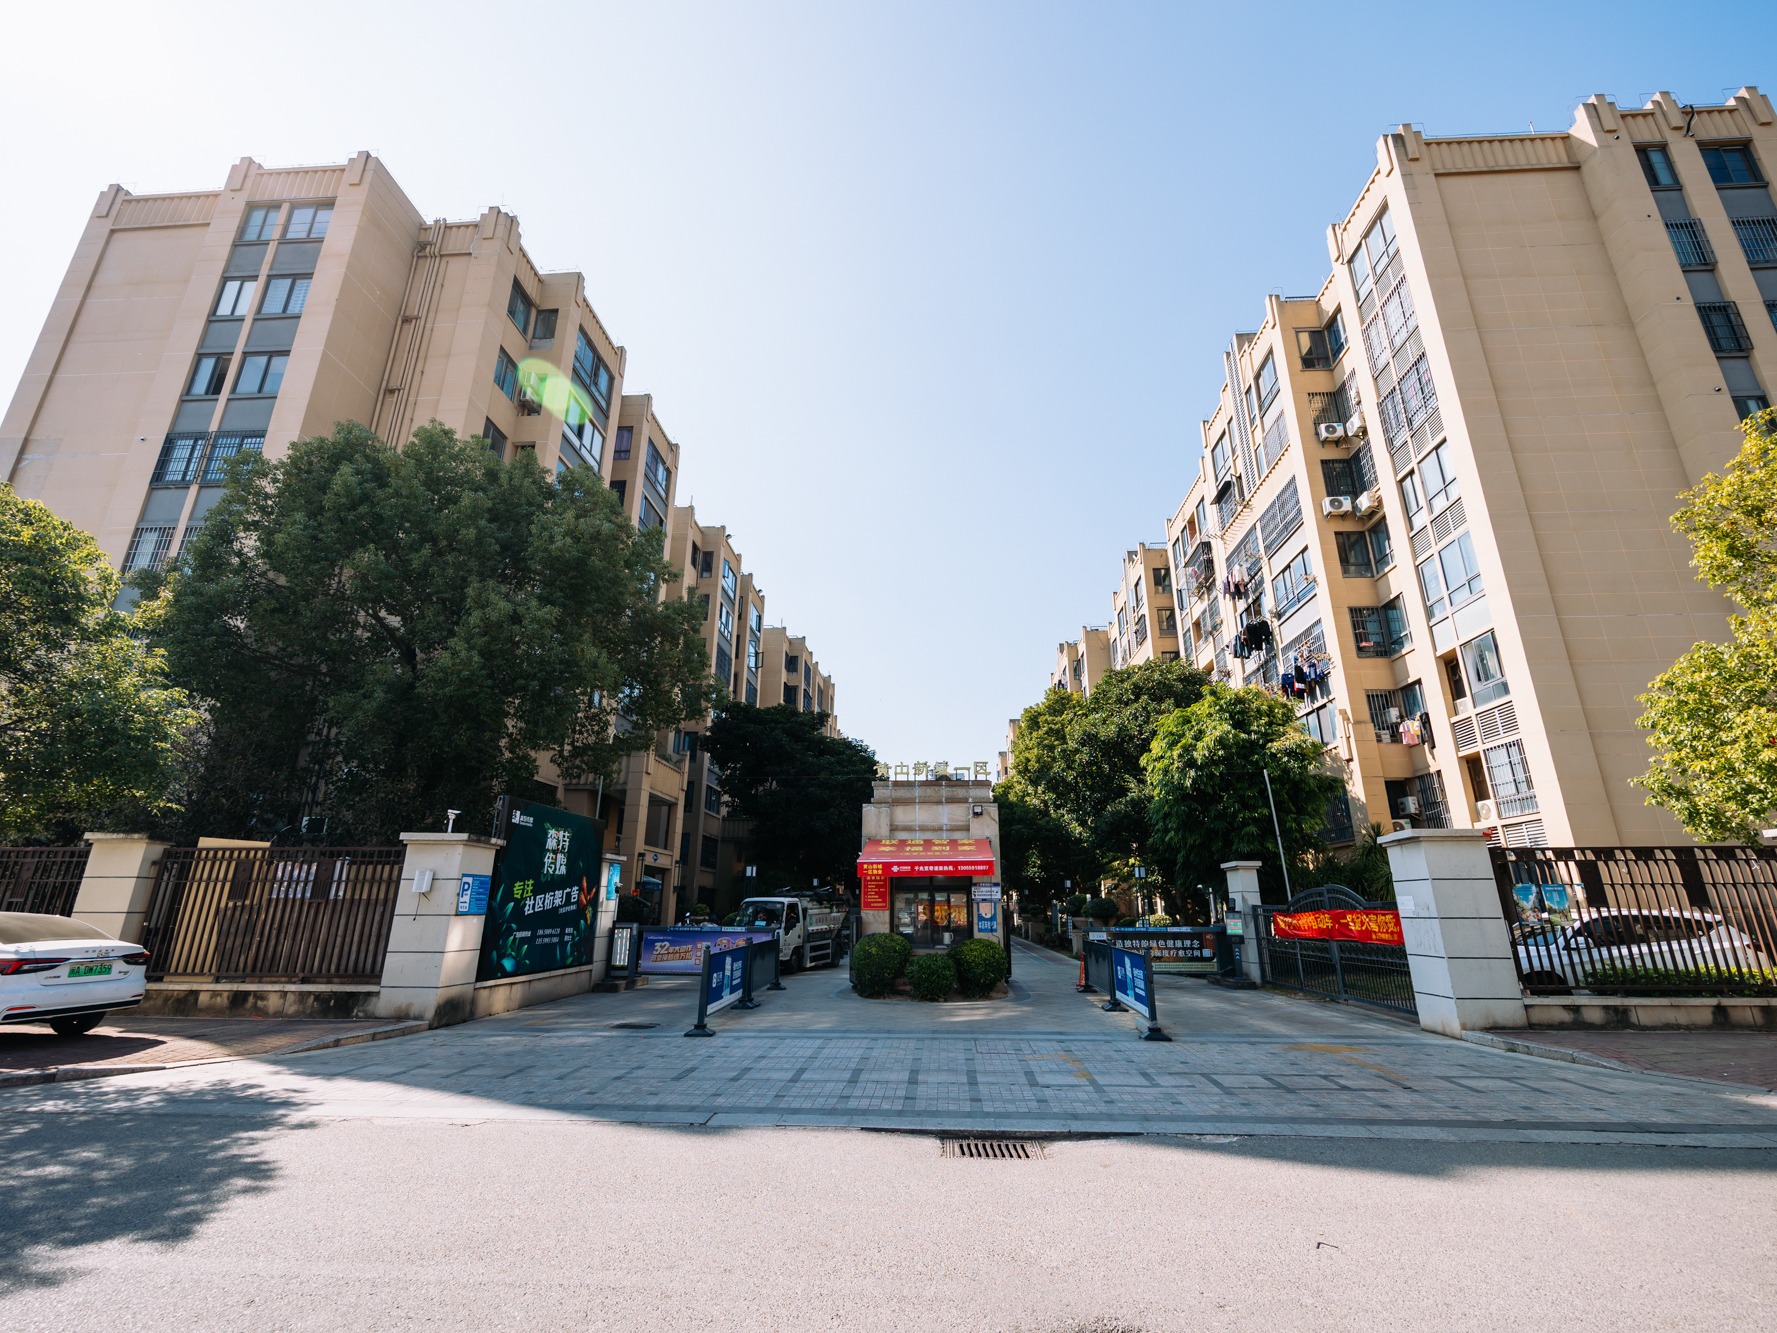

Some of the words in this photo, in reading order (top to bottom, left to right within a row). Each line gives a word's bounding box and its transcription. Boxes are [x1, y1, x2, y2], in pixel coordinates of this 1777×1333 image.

[873, 761, 991, 777] 黄山新城一区
[546, 829, 570, 852] 森特
[544, 852, 567, 875] 传媒
[513, 879, 534, 899] 专注
[524, 886, 579, 916] 社区桁架广告
[1112, 939, 1201, 948] 造独特的绿色健康理念
